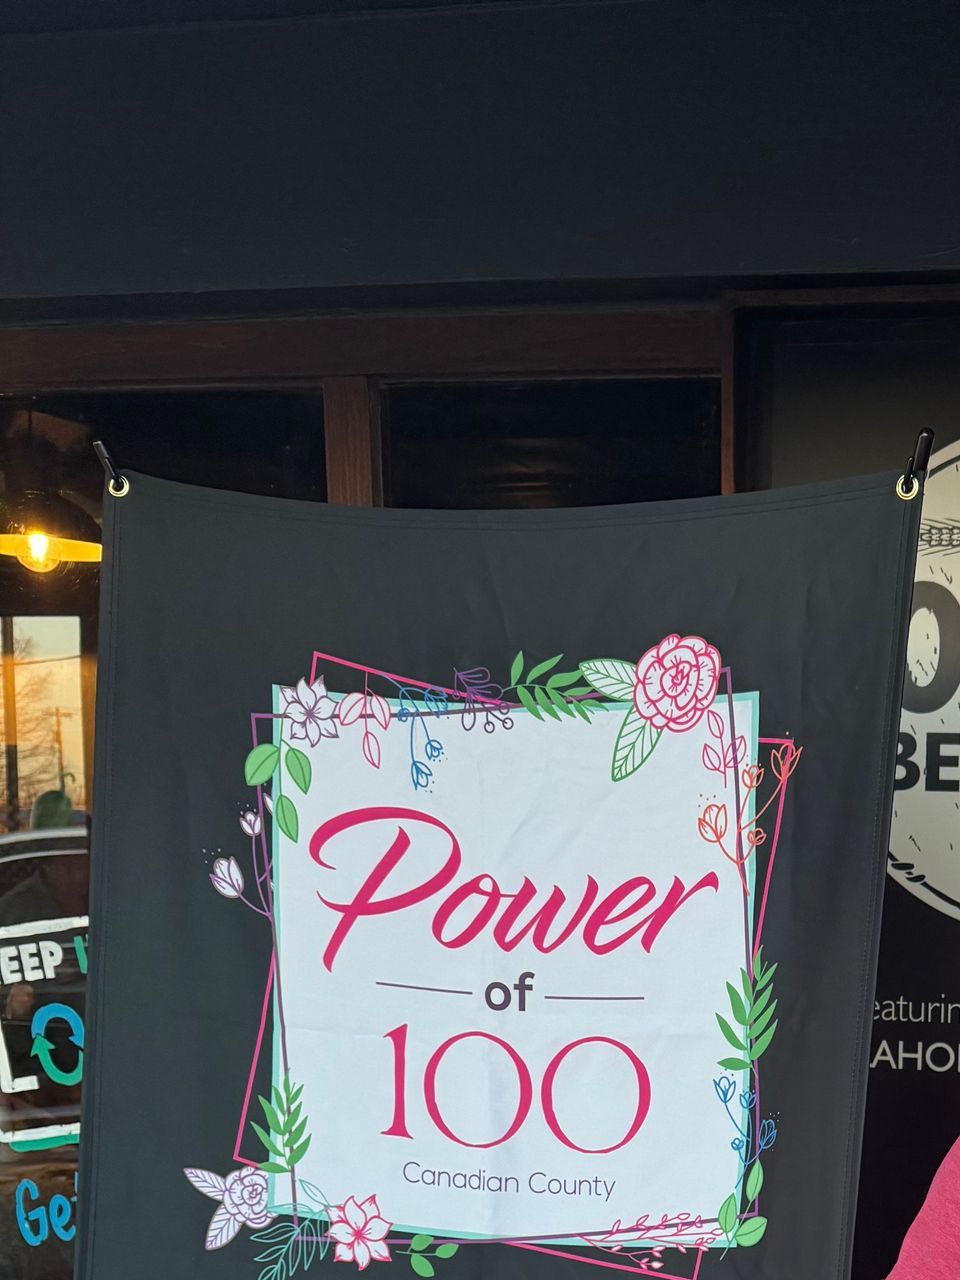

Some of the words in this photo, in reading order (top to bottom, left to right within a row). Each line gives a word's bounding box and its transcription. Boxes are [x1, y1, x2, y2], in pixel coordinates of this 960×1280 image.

[309, 806, 720, 973] Power
[0, 940, 64, 985] EEP
[485, 972, 536, 1012] of
[380, 1023, 651, 1154] 100
[15, 1172, 78, 1247] Ge
[402, 1162, 519, 1193] Canadian
[528, 1172, 616, 1202] County
